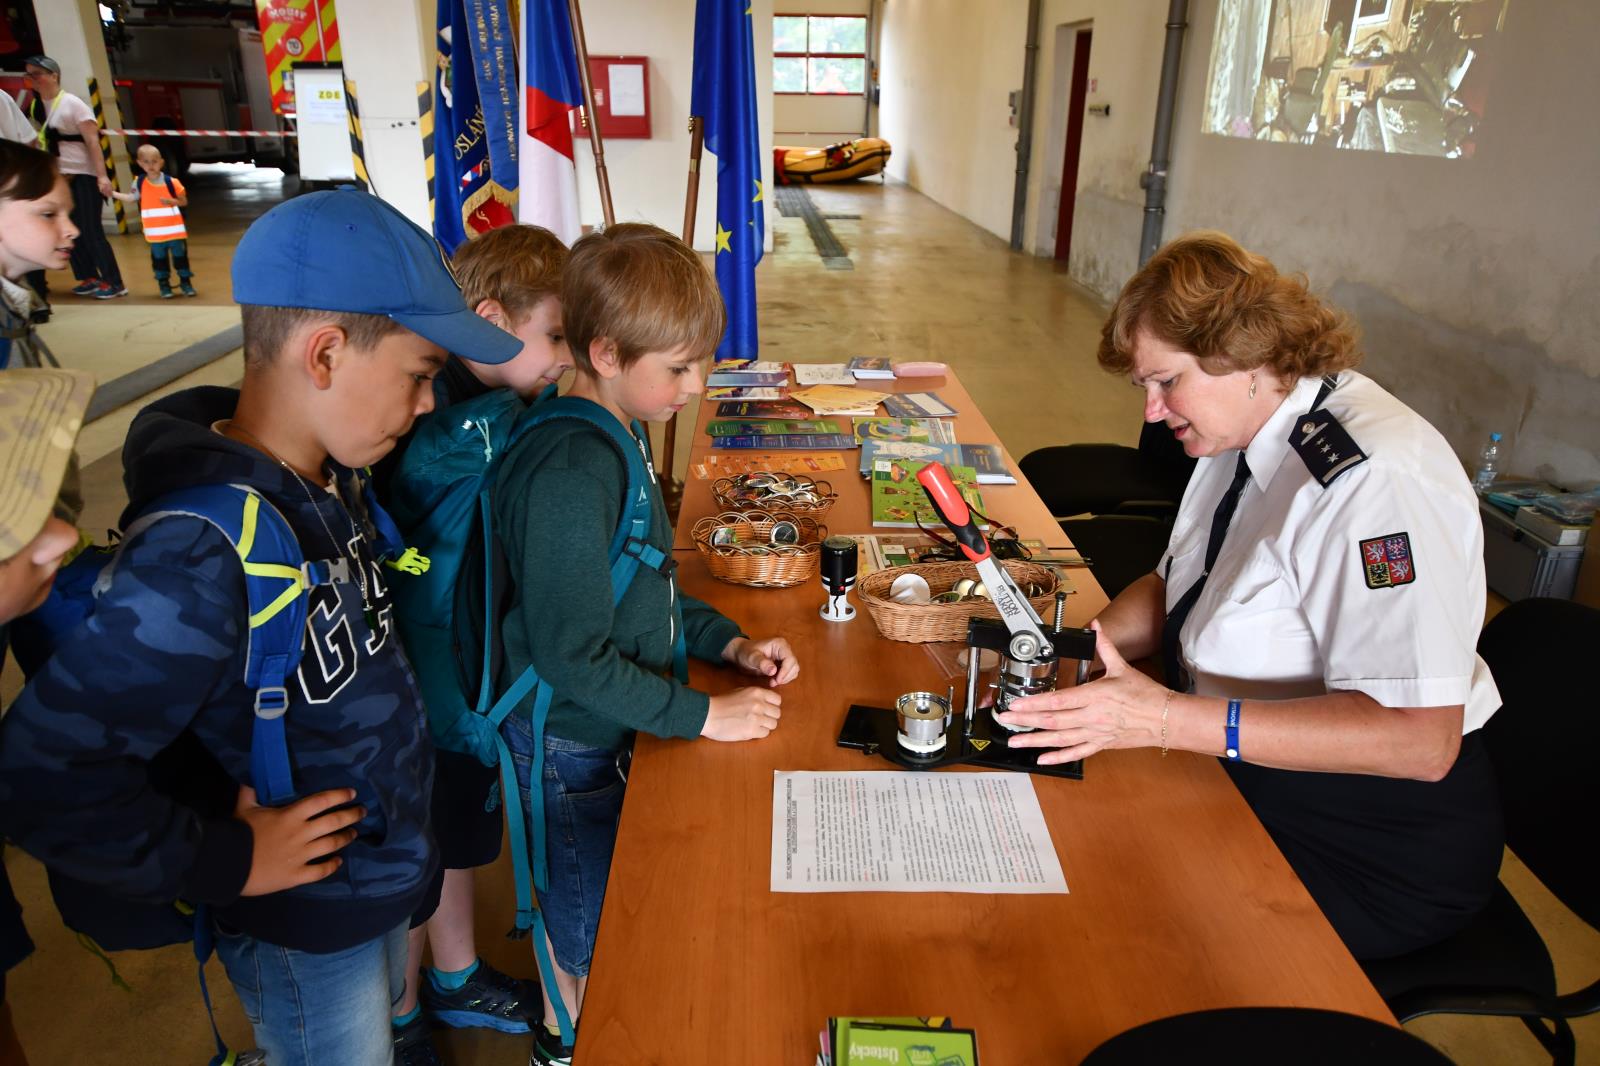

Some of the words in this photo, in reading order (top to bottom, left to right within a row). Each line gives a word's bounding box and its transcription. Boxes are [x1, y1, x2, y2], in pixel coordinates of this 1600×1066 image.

[318, 90, 341, 100] ZDE
[994, 593, 1014, 618] AKER
[996, 584, 1021, 616] BUTTON
[848, 1042, 899, 1065] Ústecký
